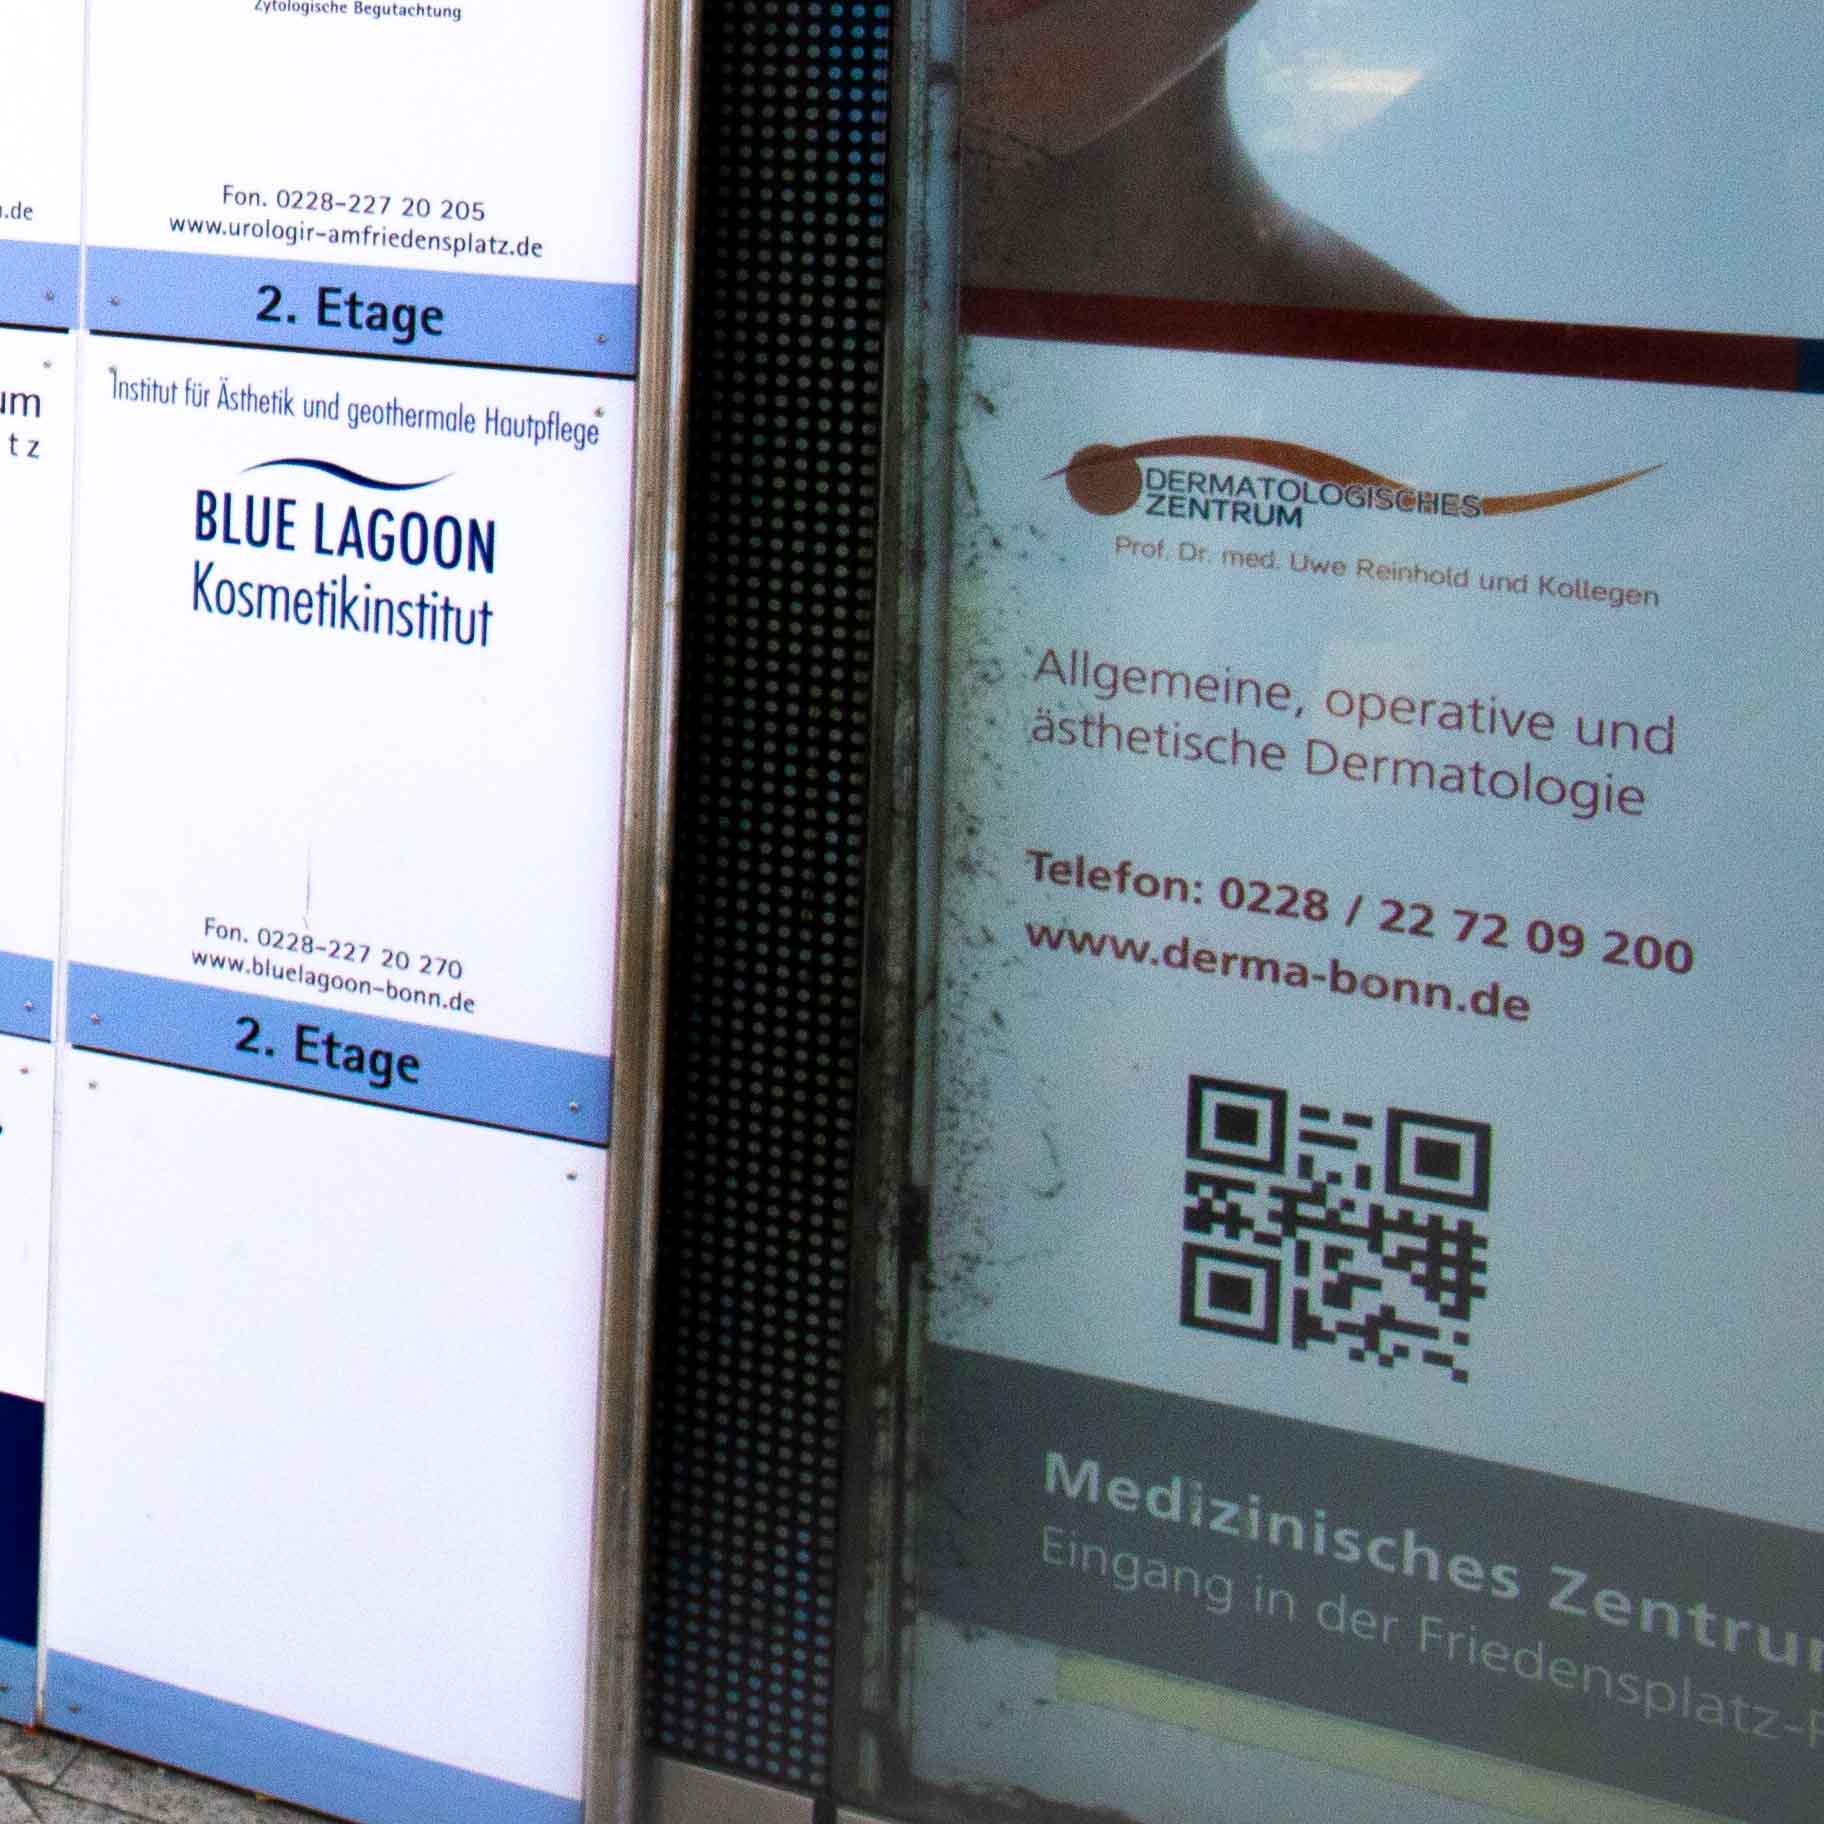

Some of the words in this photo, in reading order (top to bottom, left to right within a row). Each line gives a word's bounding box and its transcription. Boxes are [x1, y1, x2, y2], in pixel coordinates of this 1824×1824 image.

[256, 284, 296, 325] 2.
[317, 286, 445, 343] Etage
[195, 489, 297, 552] BLUE
[315, 502, 496, 574] LAGOON
[1141, 467, 1487, 519] DERMATOLOGISCHES
[1146, 494, 1303, 529] ZENTRUM
[193, 560, 494, 648] Kosmetikinstitut
[1031, 646, 1304, 720] Allgemeine,
[1326, 689, 1556, 742] operative
[1576, 714, 1676, 757] und
[1027, 708, 1287, 772] ästhetische
[1306, 738, 1648, 817] Dermatologie
[1025, 848, 1202, 905] Telefon:
[1219, 876, 1329, 922] 0228
[1345, 895, 1363, 927] /
[1379, 898, 1434, 938] 22
[1453, 908, 1508, 949] 72
[1526, 919, 1585, 959] 09
[1602, 929, 1695, 975] 200
[191, 952, 475, 1014] www.bluelagoon-bonn.de
[1024, 921, 1531, 1022] www.derma-bonn.de
[235, 1016, 275, 1059] 2.
[295, 1024, 421, 1086] Etage
[1046, 1451, 1520, 1599] Medizinisches
